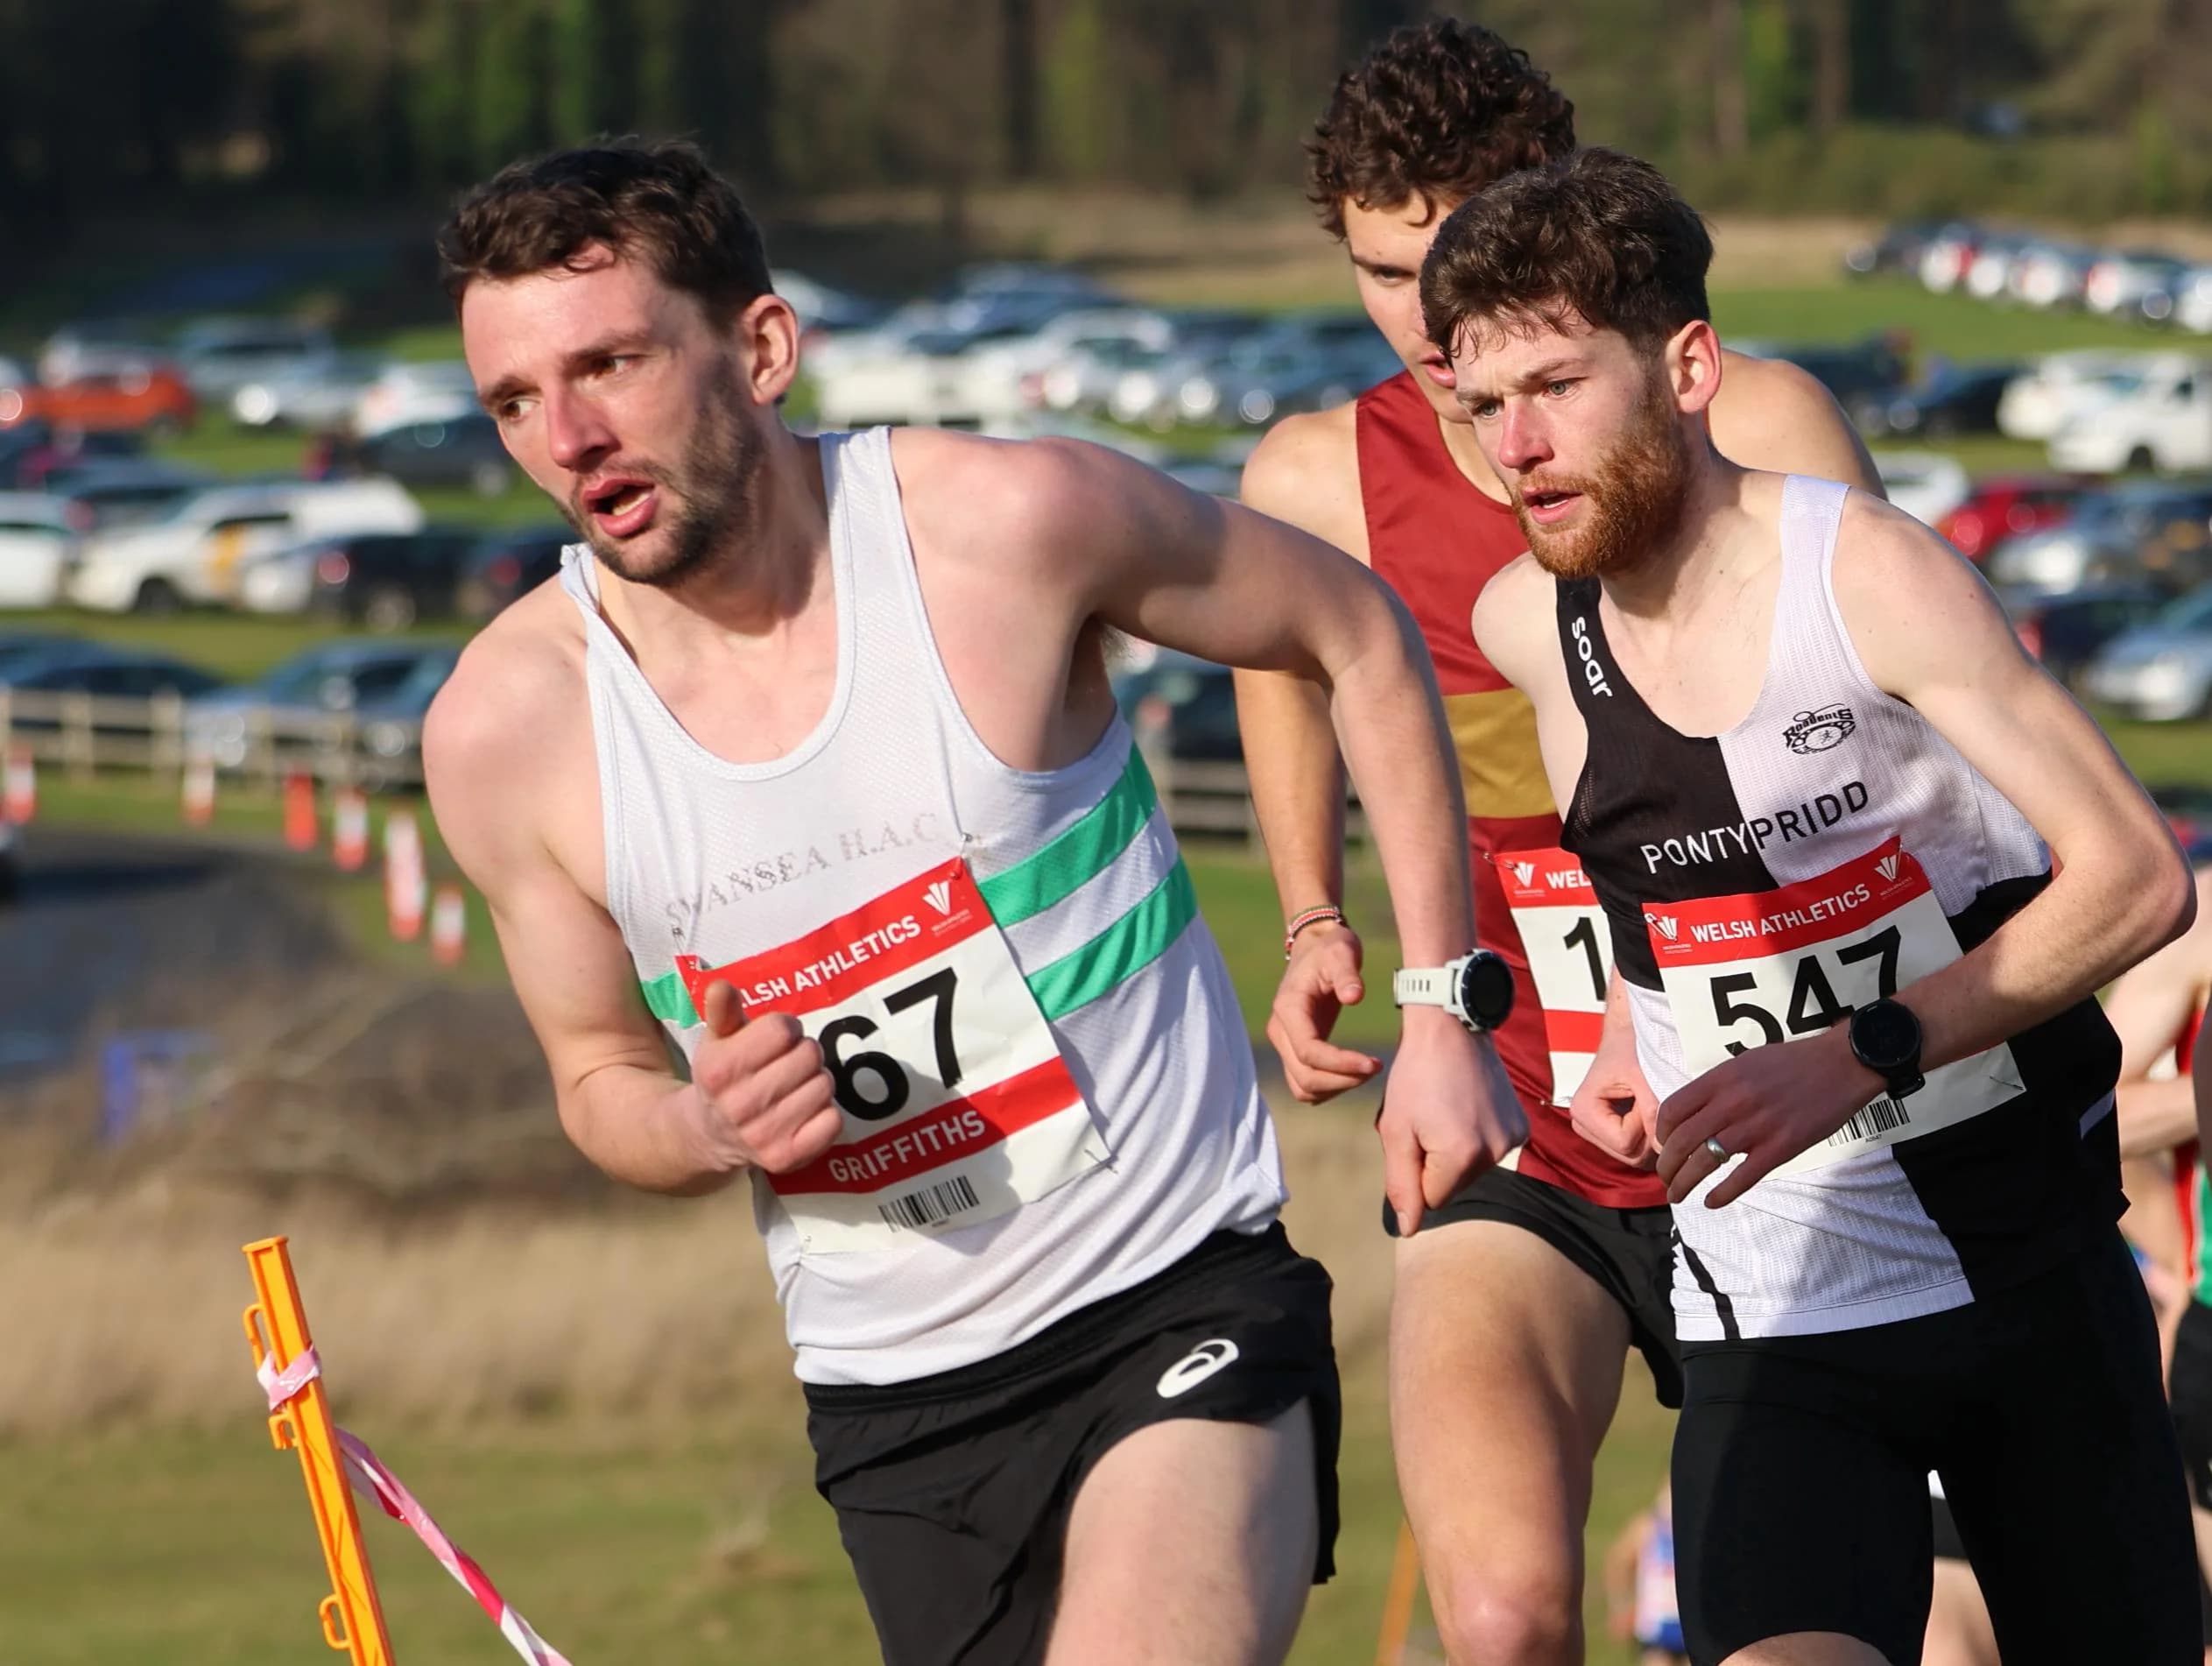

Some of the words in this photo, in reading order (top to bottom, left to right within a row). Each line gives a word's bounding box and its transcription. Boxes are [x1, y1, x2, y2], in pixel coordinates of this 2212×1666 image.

[1572, 616, 1613, 697] soar
[1640, 780, 1870, 874] PONTYPRIDD
[1545, 868, 1592, 890] WEL
[1690, 918, 1757, 942] WELSH
[1759, 883, 1871, 935] ATHLETICS
[741, 977, 792, 1009] LSH
[793, 914, 921, 992] ATHLETICS
[1709, 924, 1902, 1057] 547
[828, 1110, 985, 1182] GRIFFITHS
